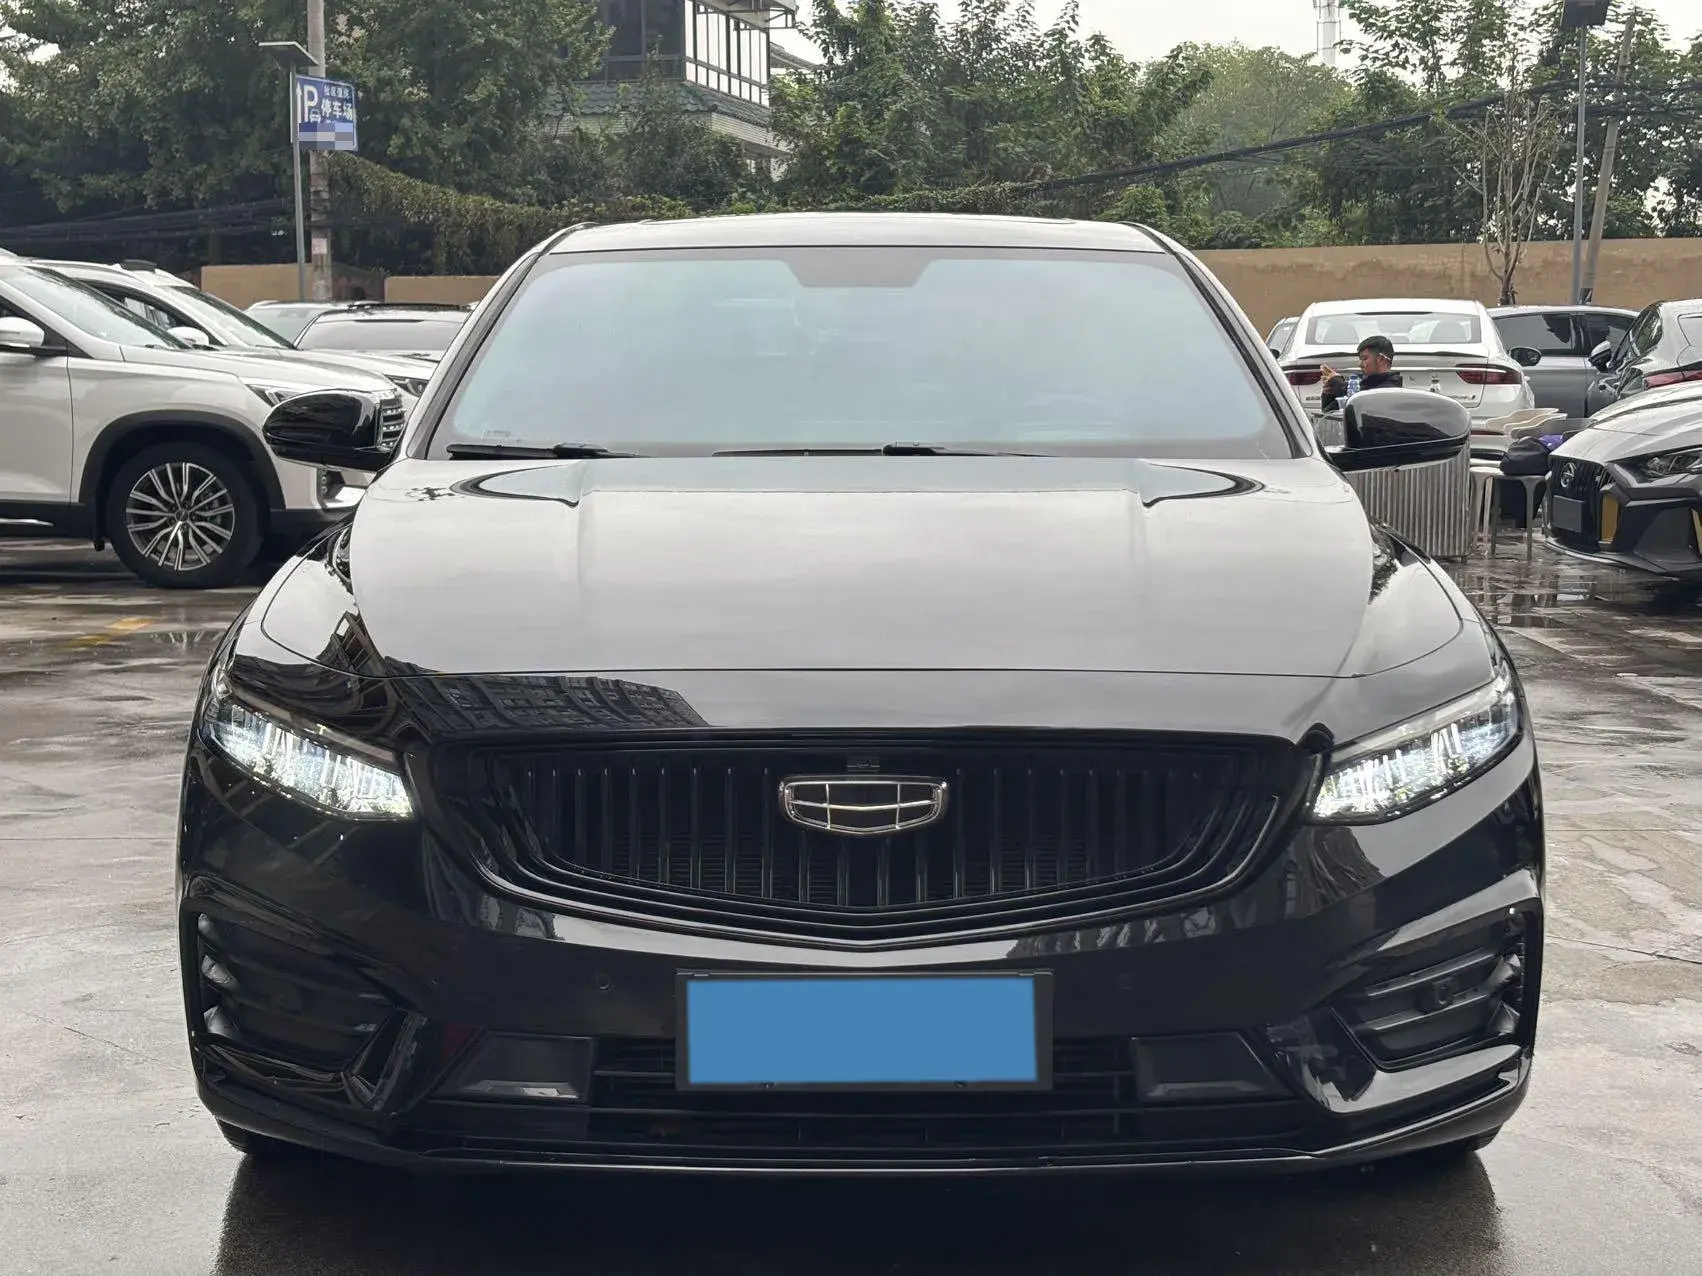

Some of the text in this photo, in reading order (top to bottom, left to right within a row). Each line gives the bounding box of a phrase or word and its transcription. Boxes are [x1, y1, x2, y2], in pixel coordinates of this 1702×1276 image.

[303, 84, 319, 122] P
[321, 98, 353, 121] 停车场
